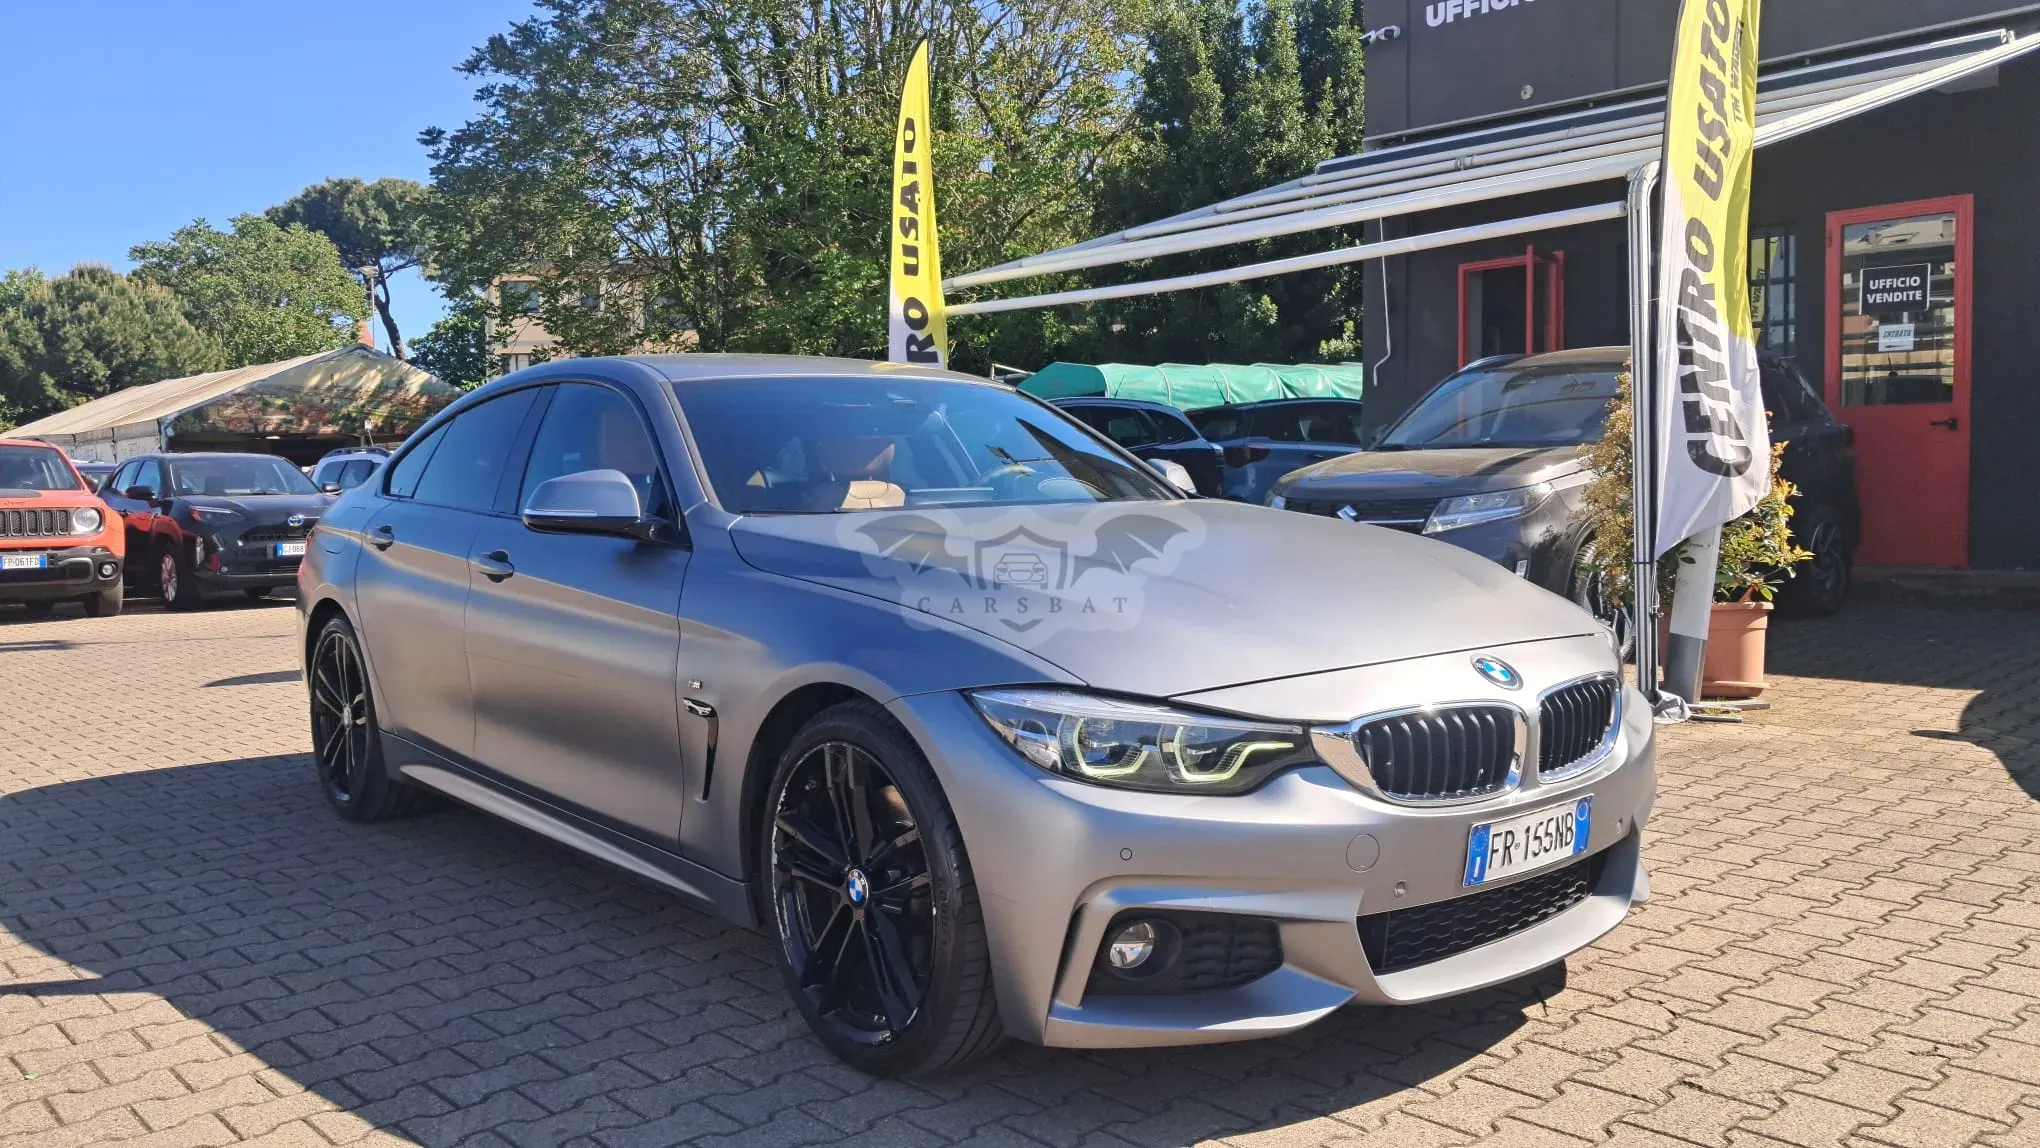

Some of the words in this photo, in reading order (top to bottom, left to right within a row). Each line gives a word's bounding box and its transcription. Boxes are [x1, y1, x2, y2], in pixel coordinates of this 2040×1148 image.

[1426, 0, 1535, 27] UFFI
[1693, 0, 1731, 202] USATO
[899, 116, 921, 277] USATO
[1866, 290, 1923, 304] VENDITE
[1869, 276, 1921, 290] UFFICIO
[902, 296, 939, 364] RO
[1677, 216, 1753, 478] CENTRO
[1882, 329, 1912, 339] ENTRATA
[1488, 829, 1516, 870] FR
[1524, 811, 1575, 861] 155NB
